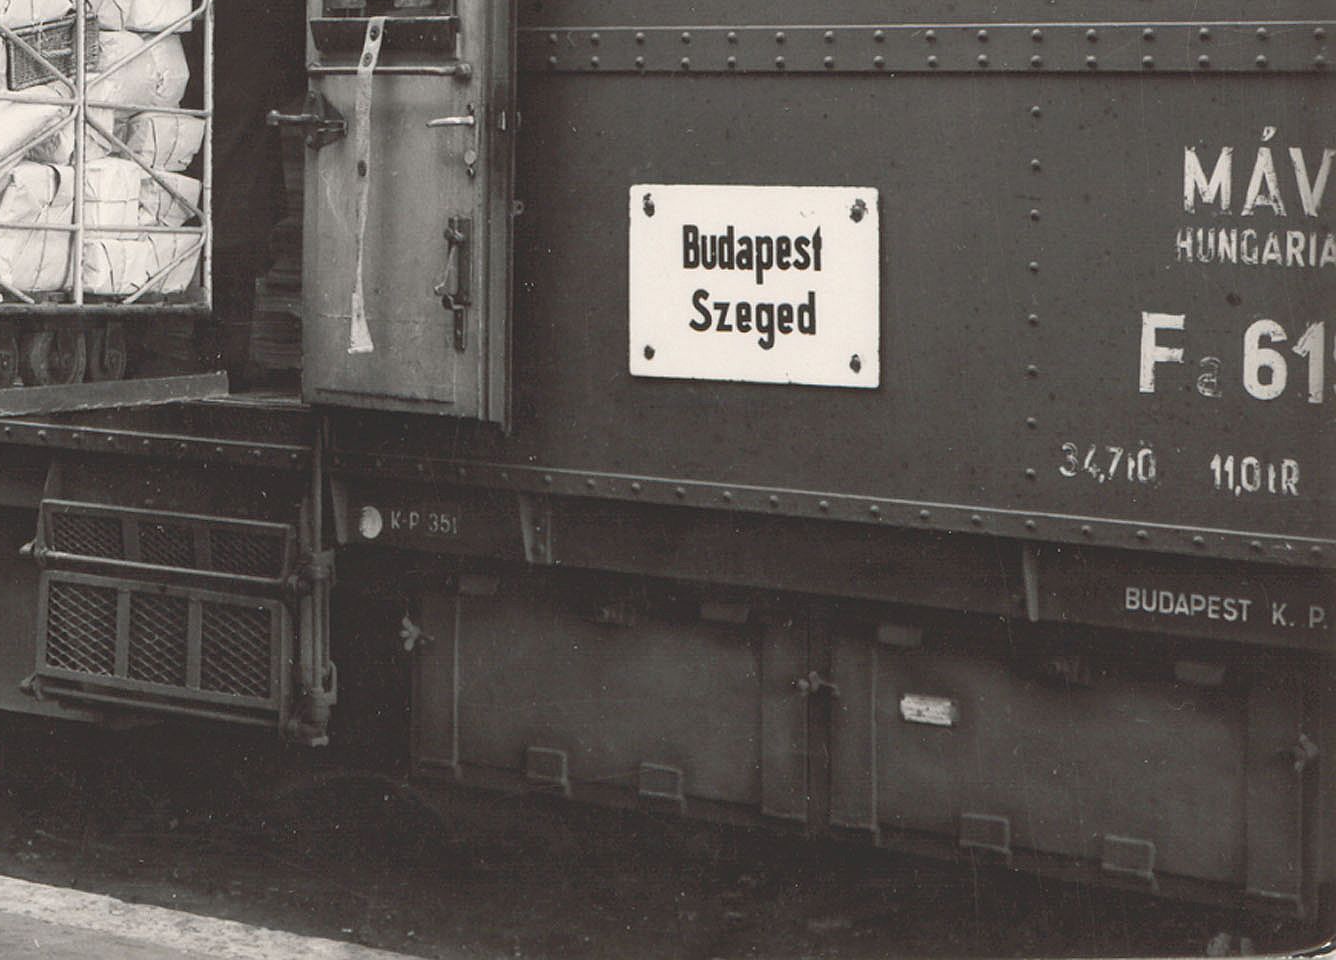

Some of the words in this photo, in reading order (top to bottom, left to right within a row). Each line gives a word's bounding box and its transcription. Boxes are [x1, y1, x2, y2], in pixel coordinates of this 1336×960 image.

[1183, 125, 1336, 218] MÁV
[682, 224, 823, 285] Budapest
[688, 289, 817, 351] Szeged
[1243, 318, 1336, 404] 61
[1125, 586, 1253, 623] BUDAPEST
